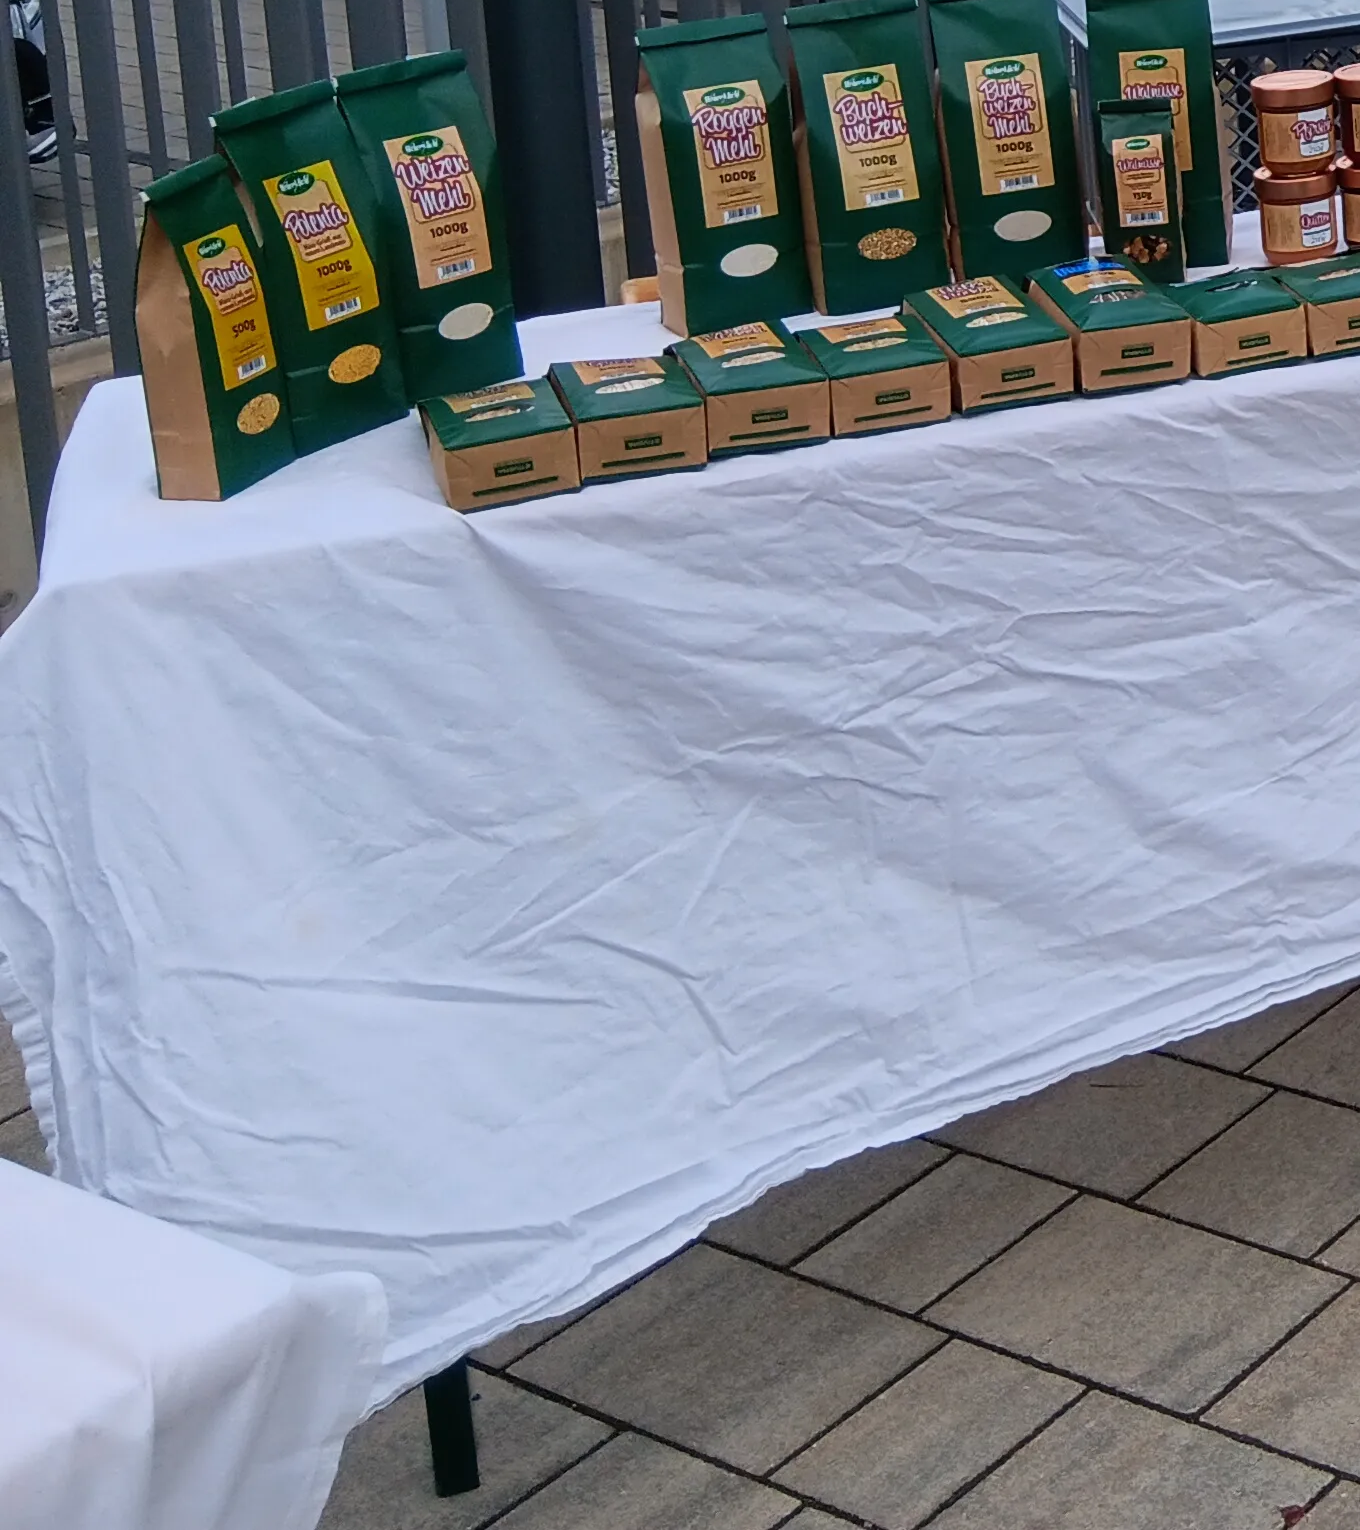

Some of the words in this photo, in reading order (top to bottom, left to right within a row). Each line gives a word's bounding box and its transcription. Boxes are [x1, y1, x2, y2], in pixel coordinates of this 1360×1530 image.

[835, 91, 904, 126] Buch-
[982, 97, 1035, 117] weizen
[692, 104, 768, 138] Roggen
[841, 118, 908, 145] weizen
[988, 114, 1035, 139] Mehl
[702, 132, 762, 167] Mehl
[996, 141, 1034, 154] 1000g
[395, 155, 470, 188] Weizen
[859, 154, 898, 168] 1000g
[719, 169, 758, 184] 1000g
[412, 181, 471, 219] Mehl
[284, 203, 350, 243] Polenta
[430, 222, 470, 239] 1000g
[202, 261, 254, 296] Polenta
[316, 259, 353, 278] 1000g
[231, 319, 257, 338] 500g
